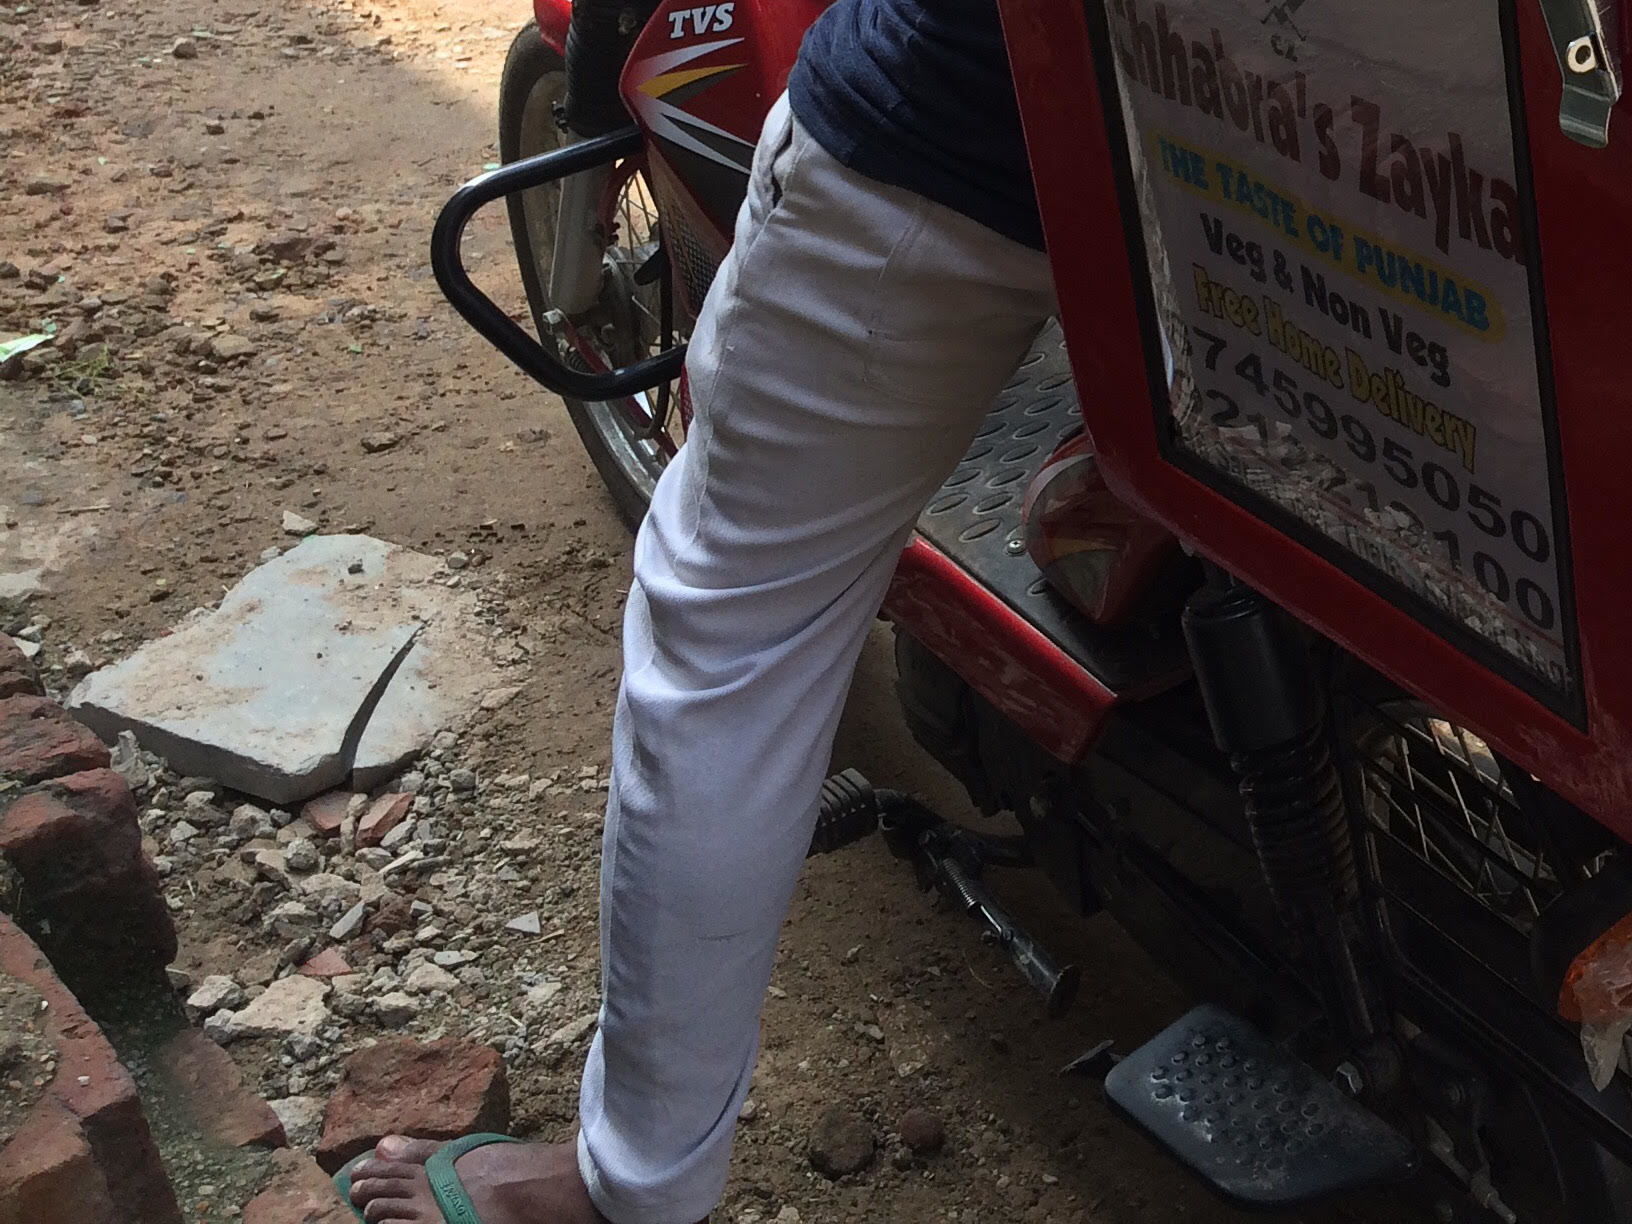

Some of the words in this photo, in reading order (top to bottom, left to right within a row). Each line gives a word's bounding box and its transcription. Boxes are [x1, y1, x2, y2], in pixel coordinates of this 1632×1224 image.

[667, 1, 736, 39] TVS
[1158, 137, 1209, 190] THE
[1215, 162, 1299, 239] TASTE
[1306, 211, 1345, 261] OF
[1354, 234, 1490, 331] PUNJAB
[1351, 95, 1527, 265] Zayka
[1193, 263, 1261, 337] Free
[1264, 295, 1345, 389] Home
[1346, 347, 1477, 474] Delivery
[1199, 212, 1265, 280] Veg
[1273, 249, 1297, 294] &
[1300, 263, 1372, 339] Non
[1379, 306, 1451, 388] Veg
